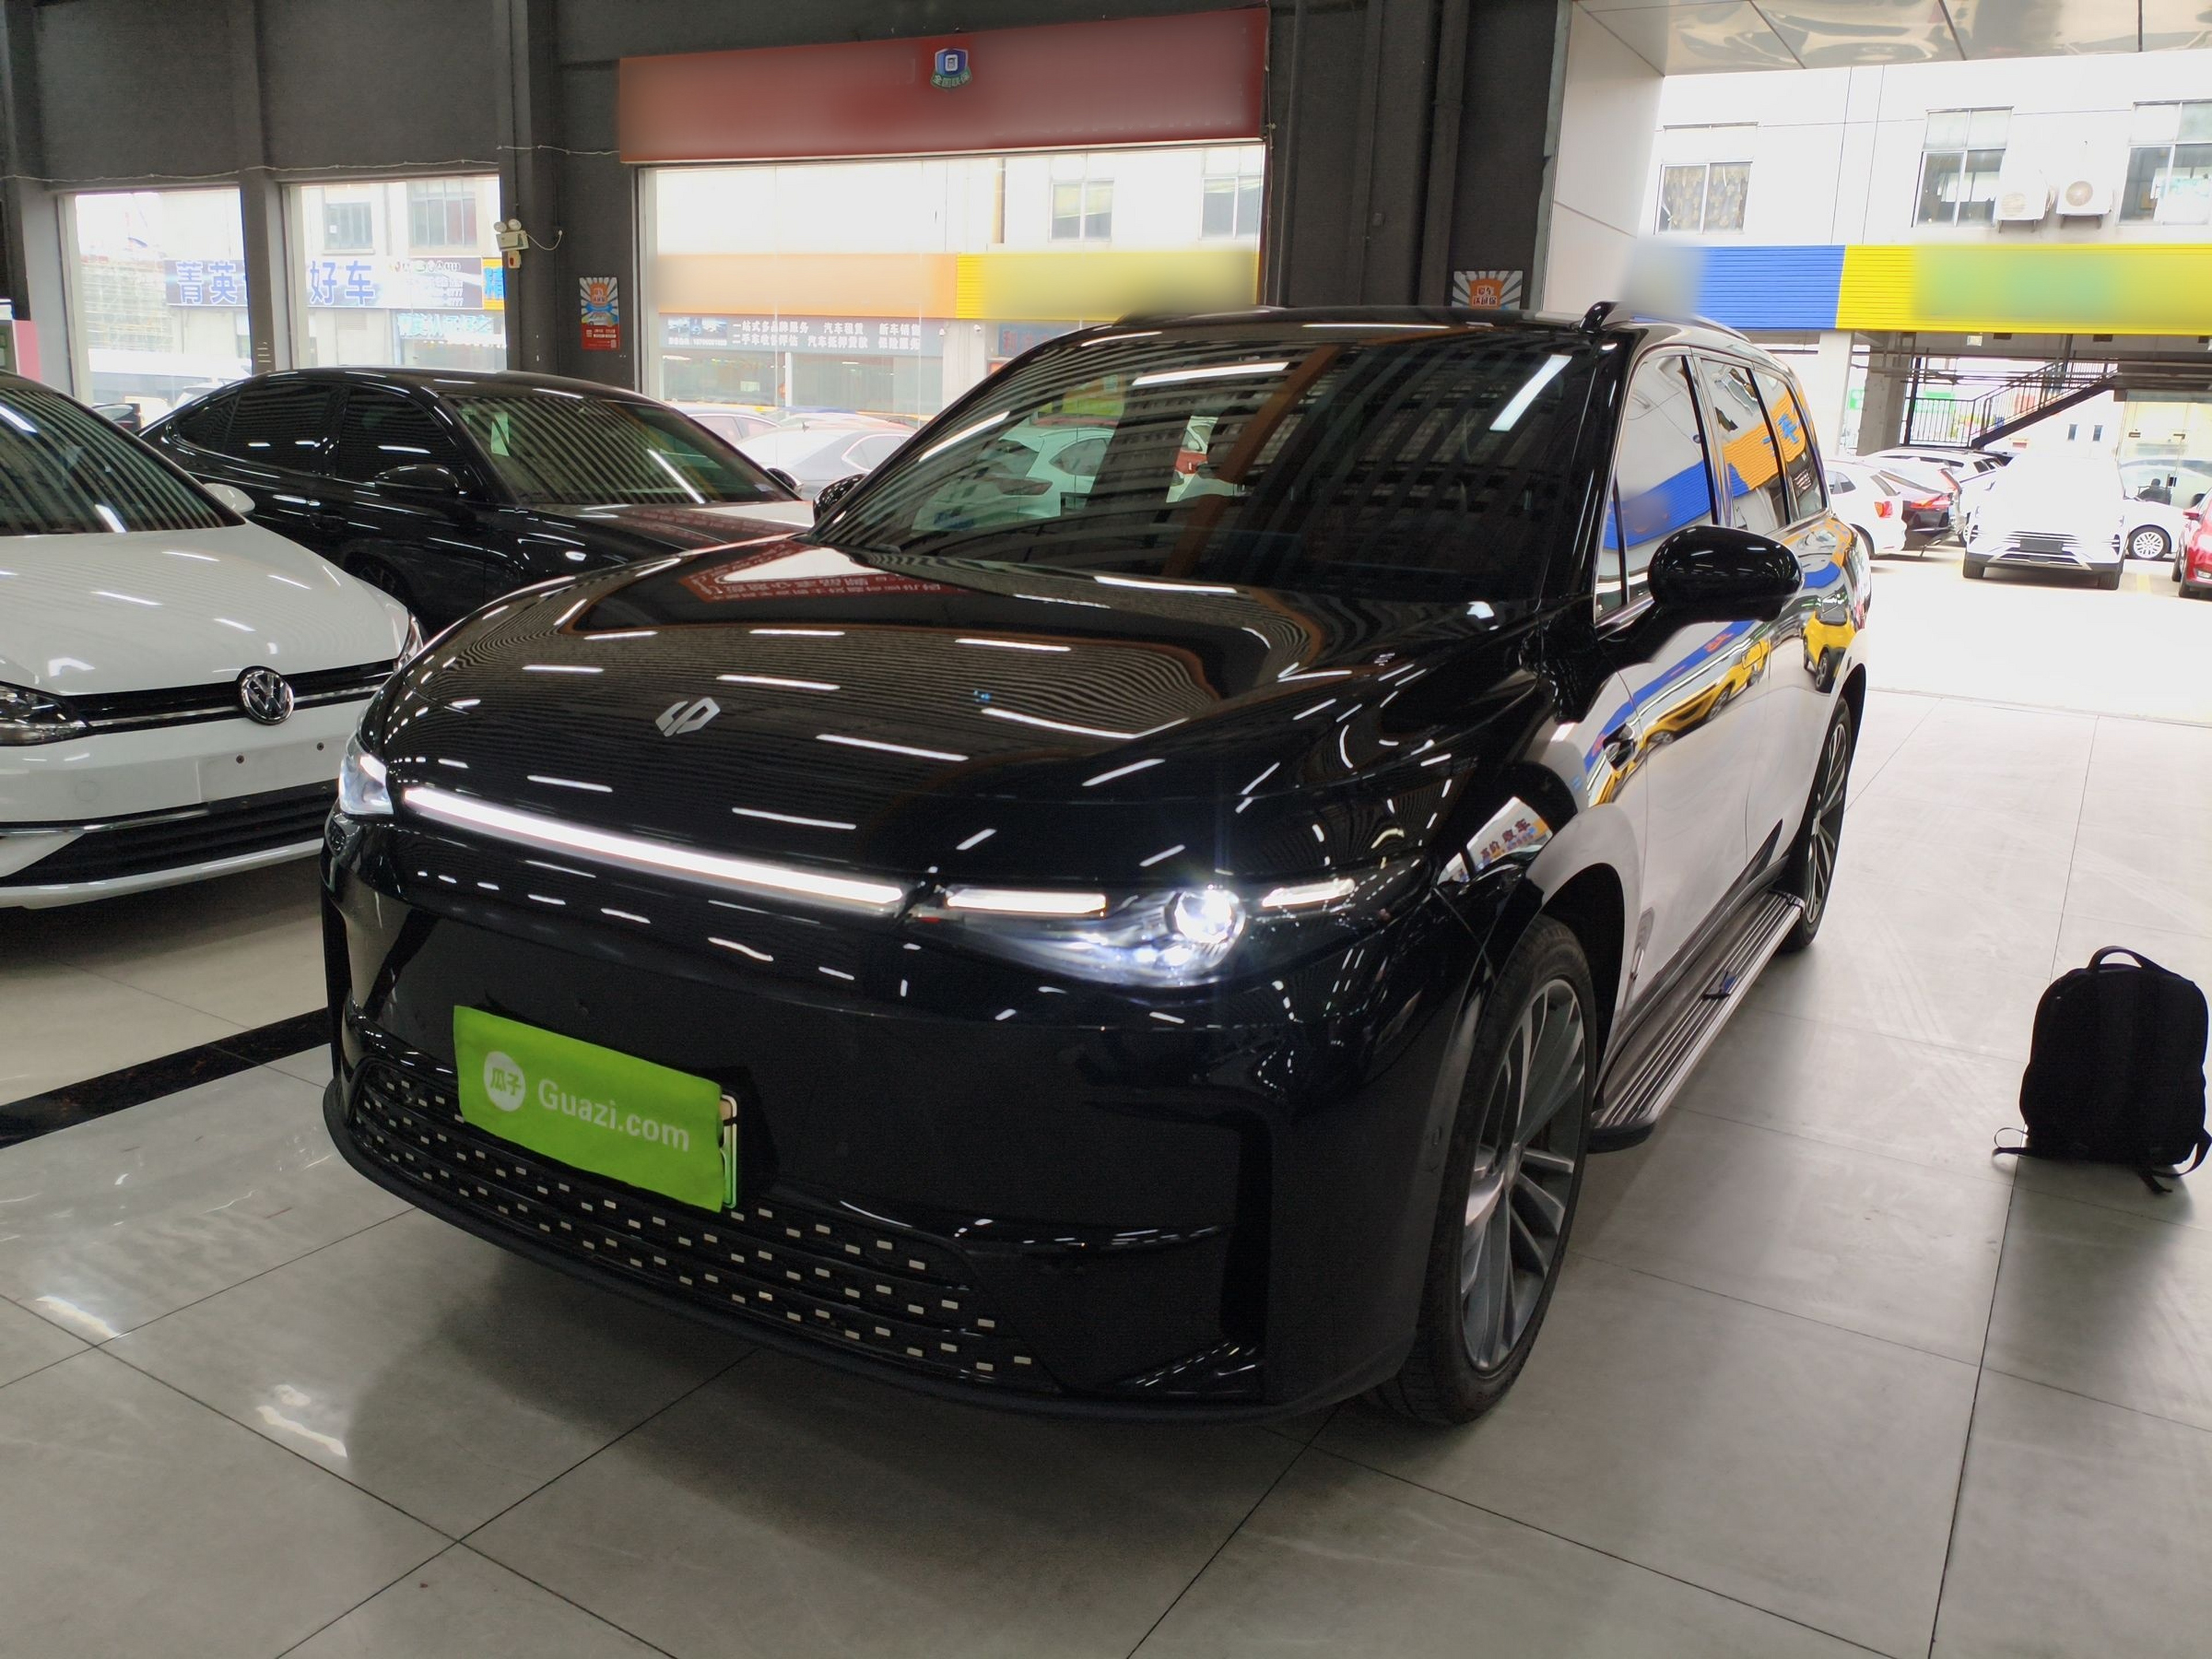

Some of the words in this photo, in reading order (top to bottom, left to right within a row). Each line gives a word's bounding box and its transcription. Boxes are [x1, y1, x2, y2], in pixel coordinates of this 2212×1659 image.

[309, 260, 376, 306] 好车
[490, 1067, 522, 1096] 瓜子
[537, 1078, 690, 1153] Guazi.com
